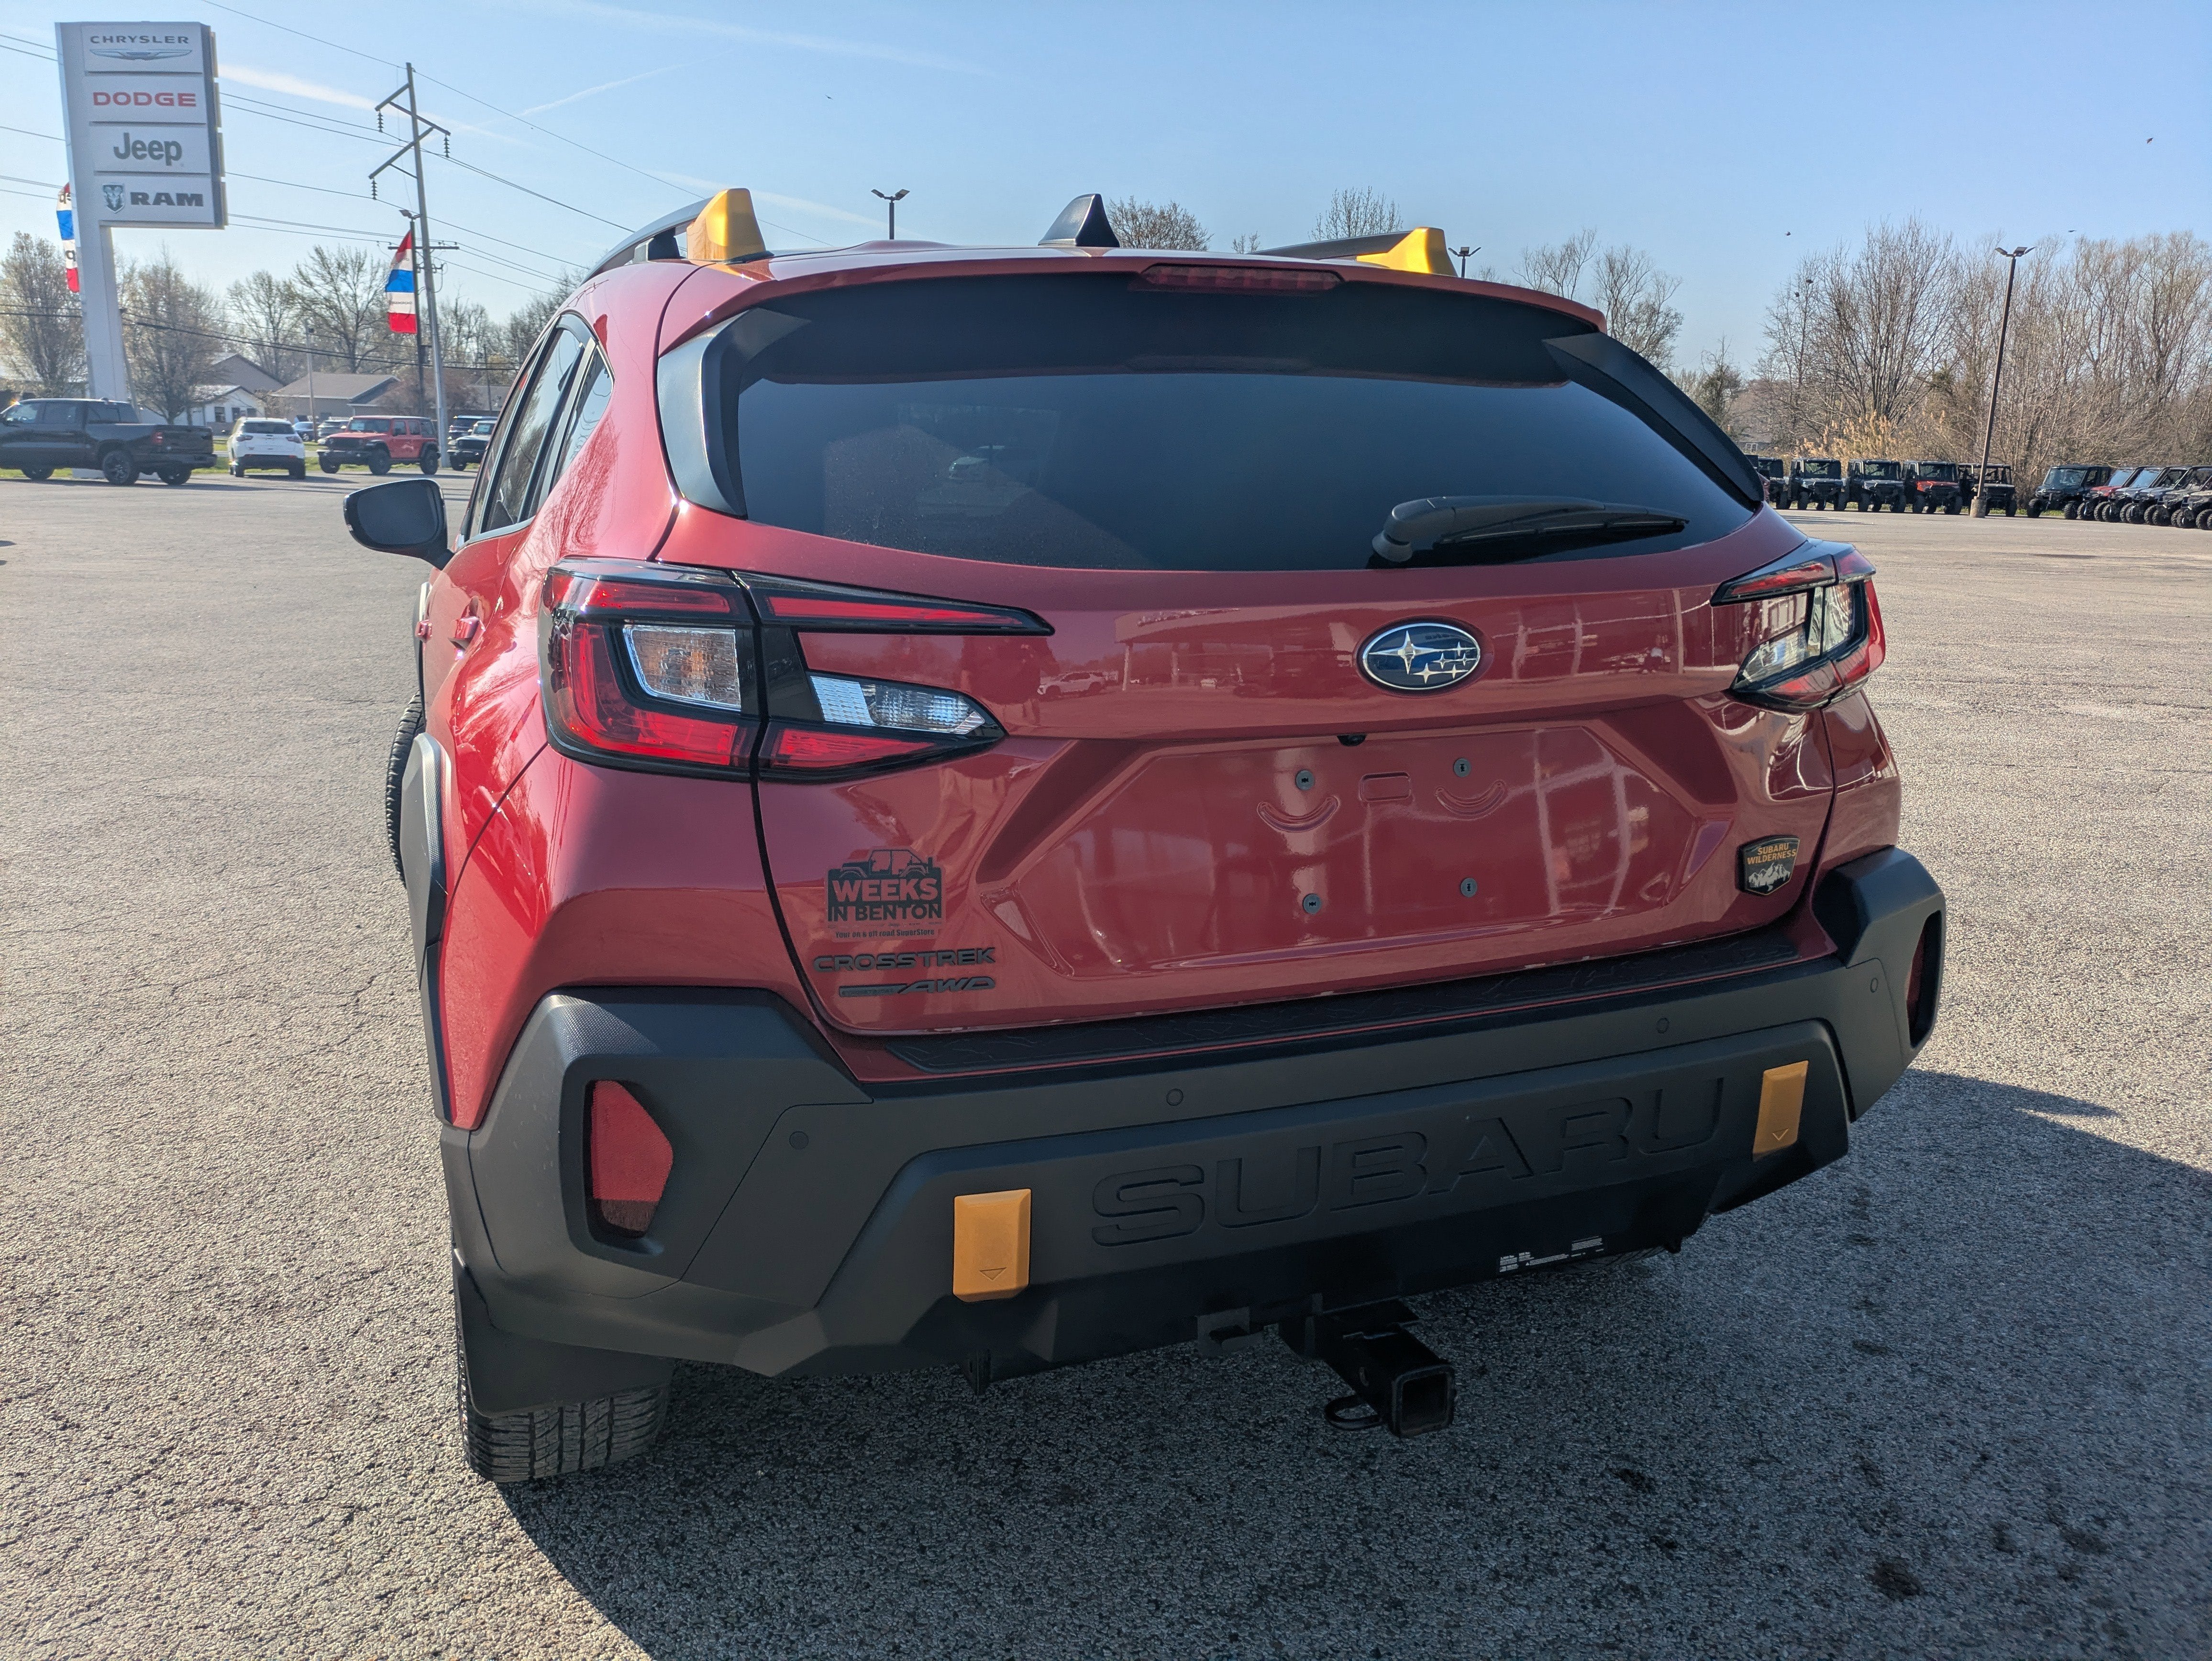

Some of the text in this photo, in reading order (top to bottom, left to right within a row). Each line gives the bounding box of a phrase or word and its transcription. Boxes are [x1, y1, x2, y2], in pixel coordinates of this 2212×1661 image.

[90, 35, 189, 44] CHRYSLER
[93, 92, 197, 107] DODGE
[113, 132, 183, 166] Jeep
[130, 192, 204, 207] RAM
[1747, 849, 1796, 864] WILDERNESS
[1758, 843, 1789, 855] SUBARU
[832, 877, 939, 902] WEEKS
[828, 903, 942, 922] IN BENTON
[813, 947, 996, 973] CROSSTREK
[897, 975, 996, 995] AWD
[1091, 1076, 1724, 1247] SUBARU
